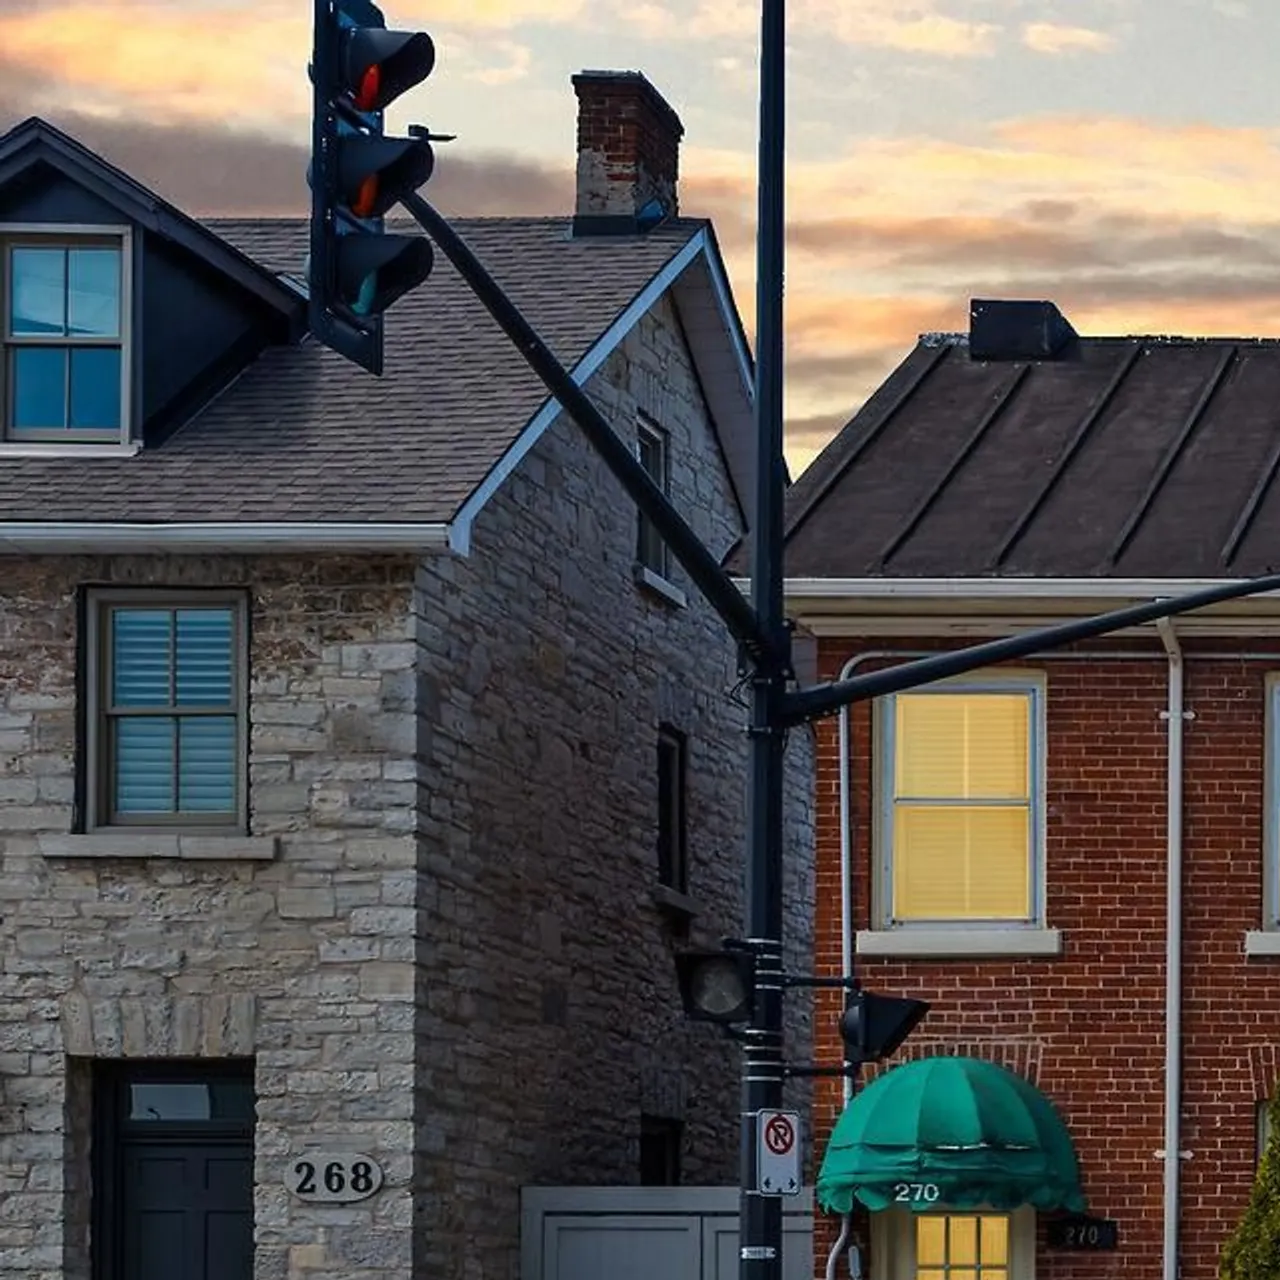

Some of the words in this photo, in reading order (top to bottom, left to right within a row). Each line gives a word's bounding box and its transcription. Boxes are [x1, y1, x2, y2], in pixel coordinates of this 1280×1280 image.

[295, 1161, 373, 1193] 268
[894, 1183, 939, 1202] 270
[1065, 1225, 1099, 1244] 270
